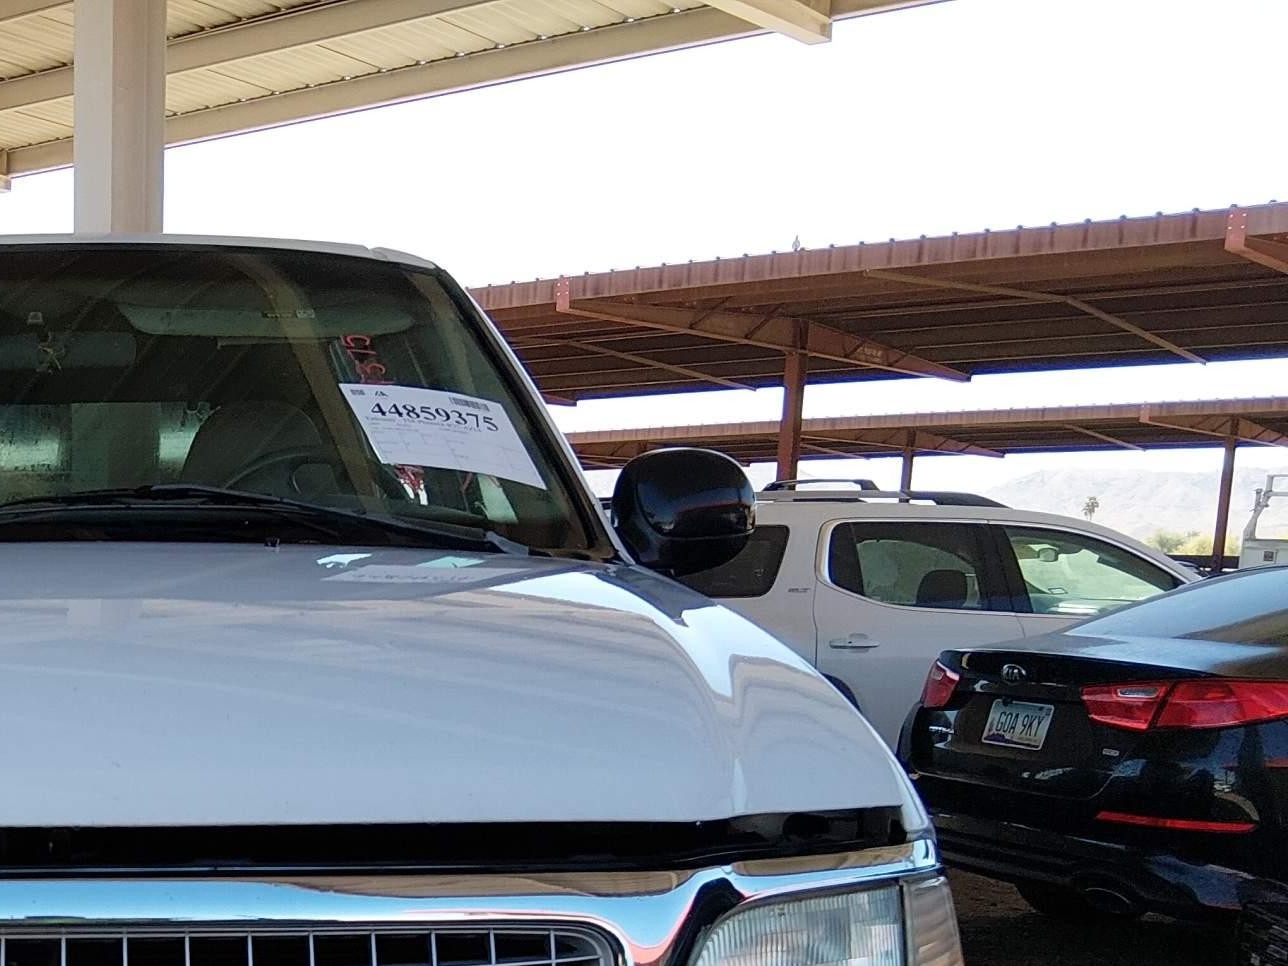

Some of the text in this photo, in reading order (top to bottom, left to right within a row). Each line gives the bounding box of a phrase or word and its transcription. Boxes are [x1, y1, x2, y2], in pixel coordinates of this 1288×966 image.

[371, 402, 499, 432] 44859375
[1002, 667, 1022, 682] KIA
[1020, 713, 1046, 738] 9KY
